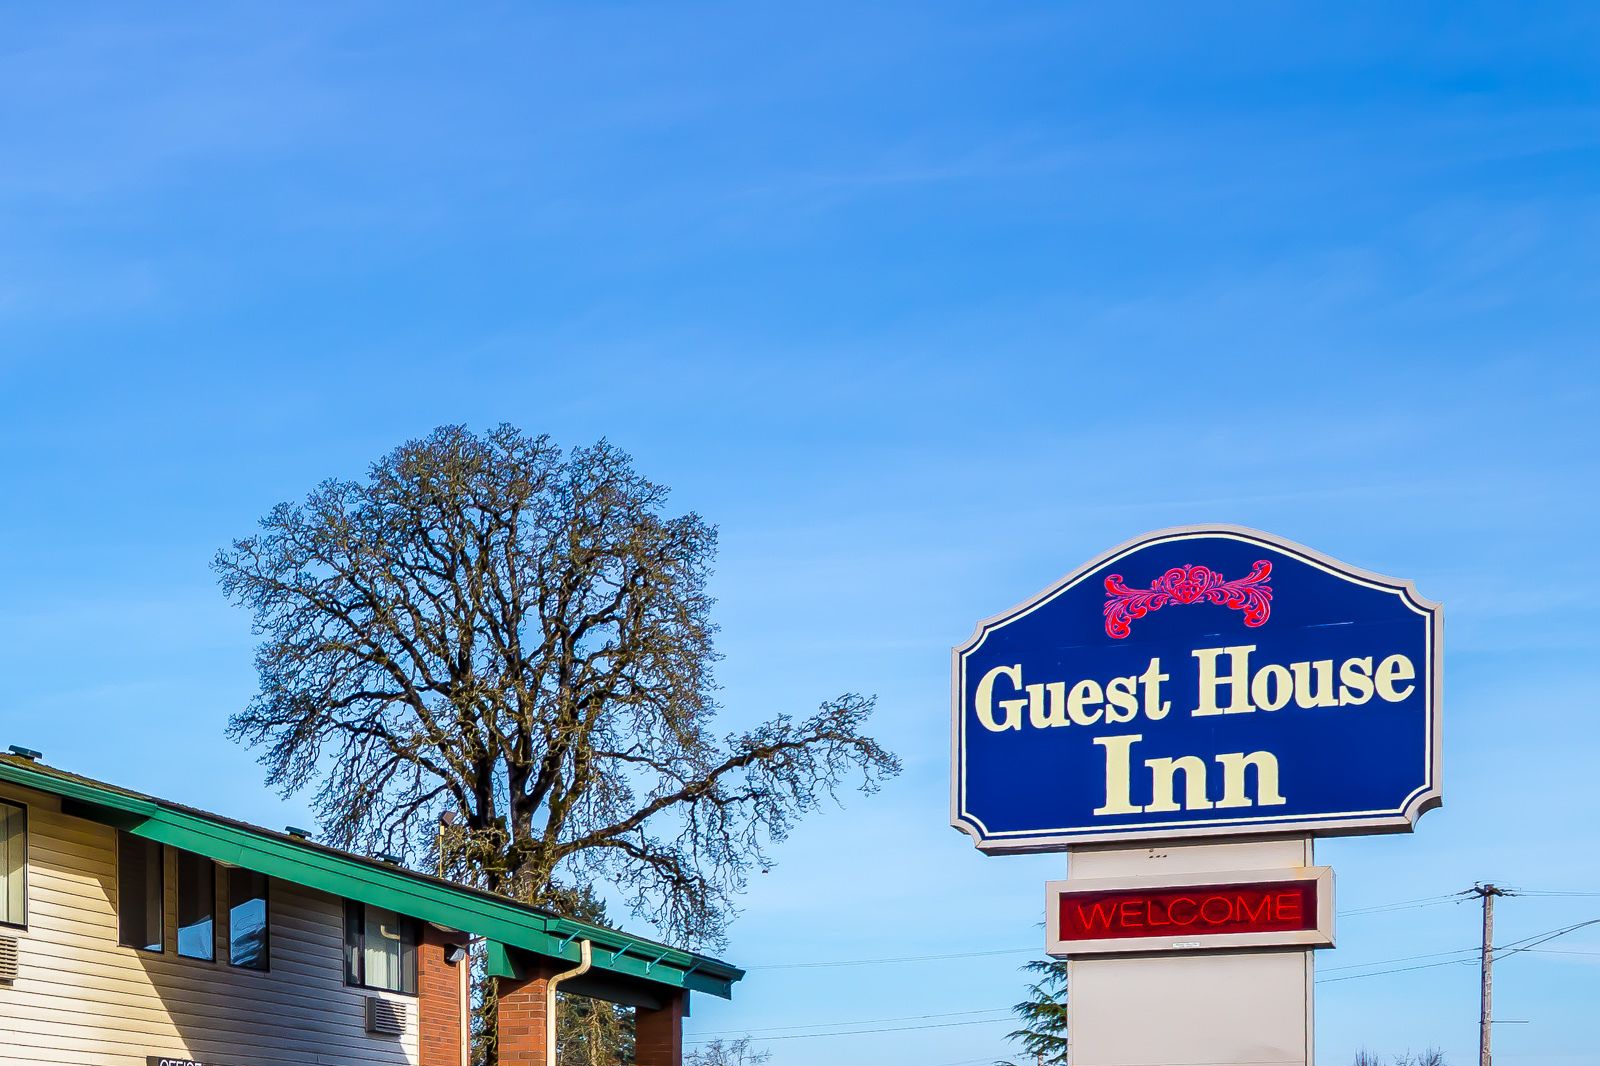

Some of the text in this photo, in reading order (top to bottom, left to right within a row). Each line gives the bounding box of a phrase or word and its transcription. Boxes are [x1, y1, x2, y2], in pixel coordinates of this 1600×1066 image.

[974, 644, 1417, 732] Guest House
[1092, 734, 1287, 816] Inn
[1077, 893, 1301, 930] WELCOME
